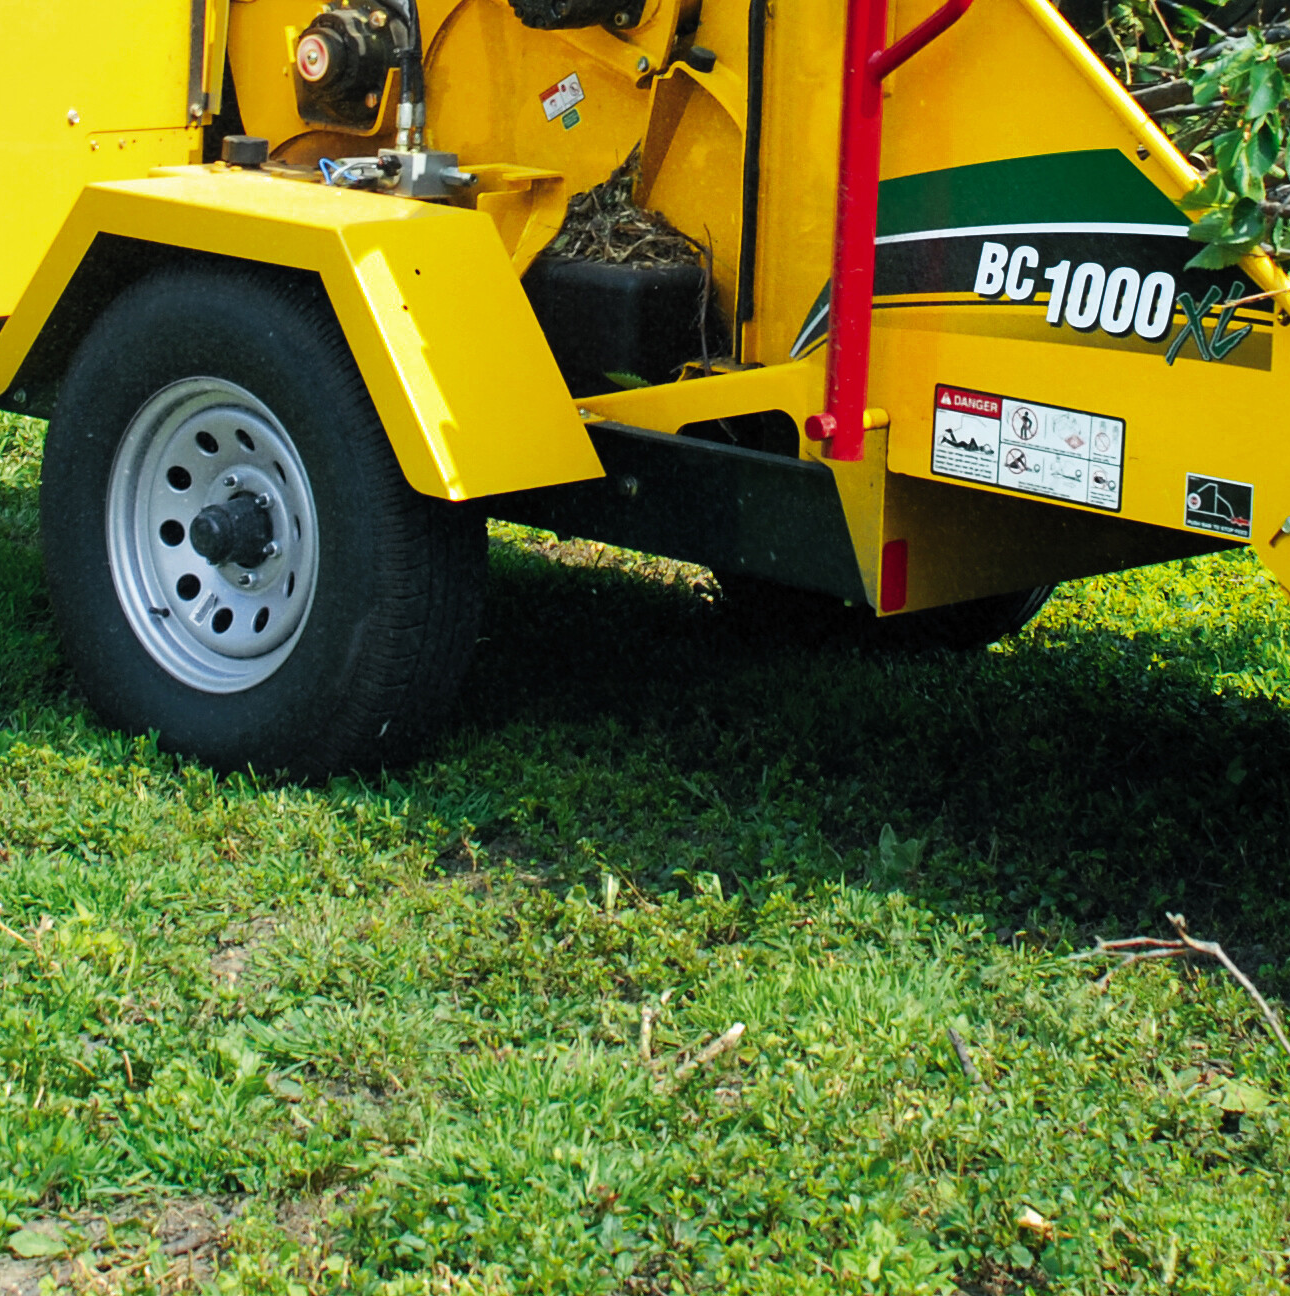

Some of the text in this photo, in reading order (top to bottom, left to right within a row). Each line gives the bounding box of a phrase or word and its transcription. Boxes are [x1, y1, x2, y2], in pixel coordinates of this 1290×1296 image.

[973, 241, 1253, 366] BC 1000 XL
[954, 395, 998, 413] DANGER
